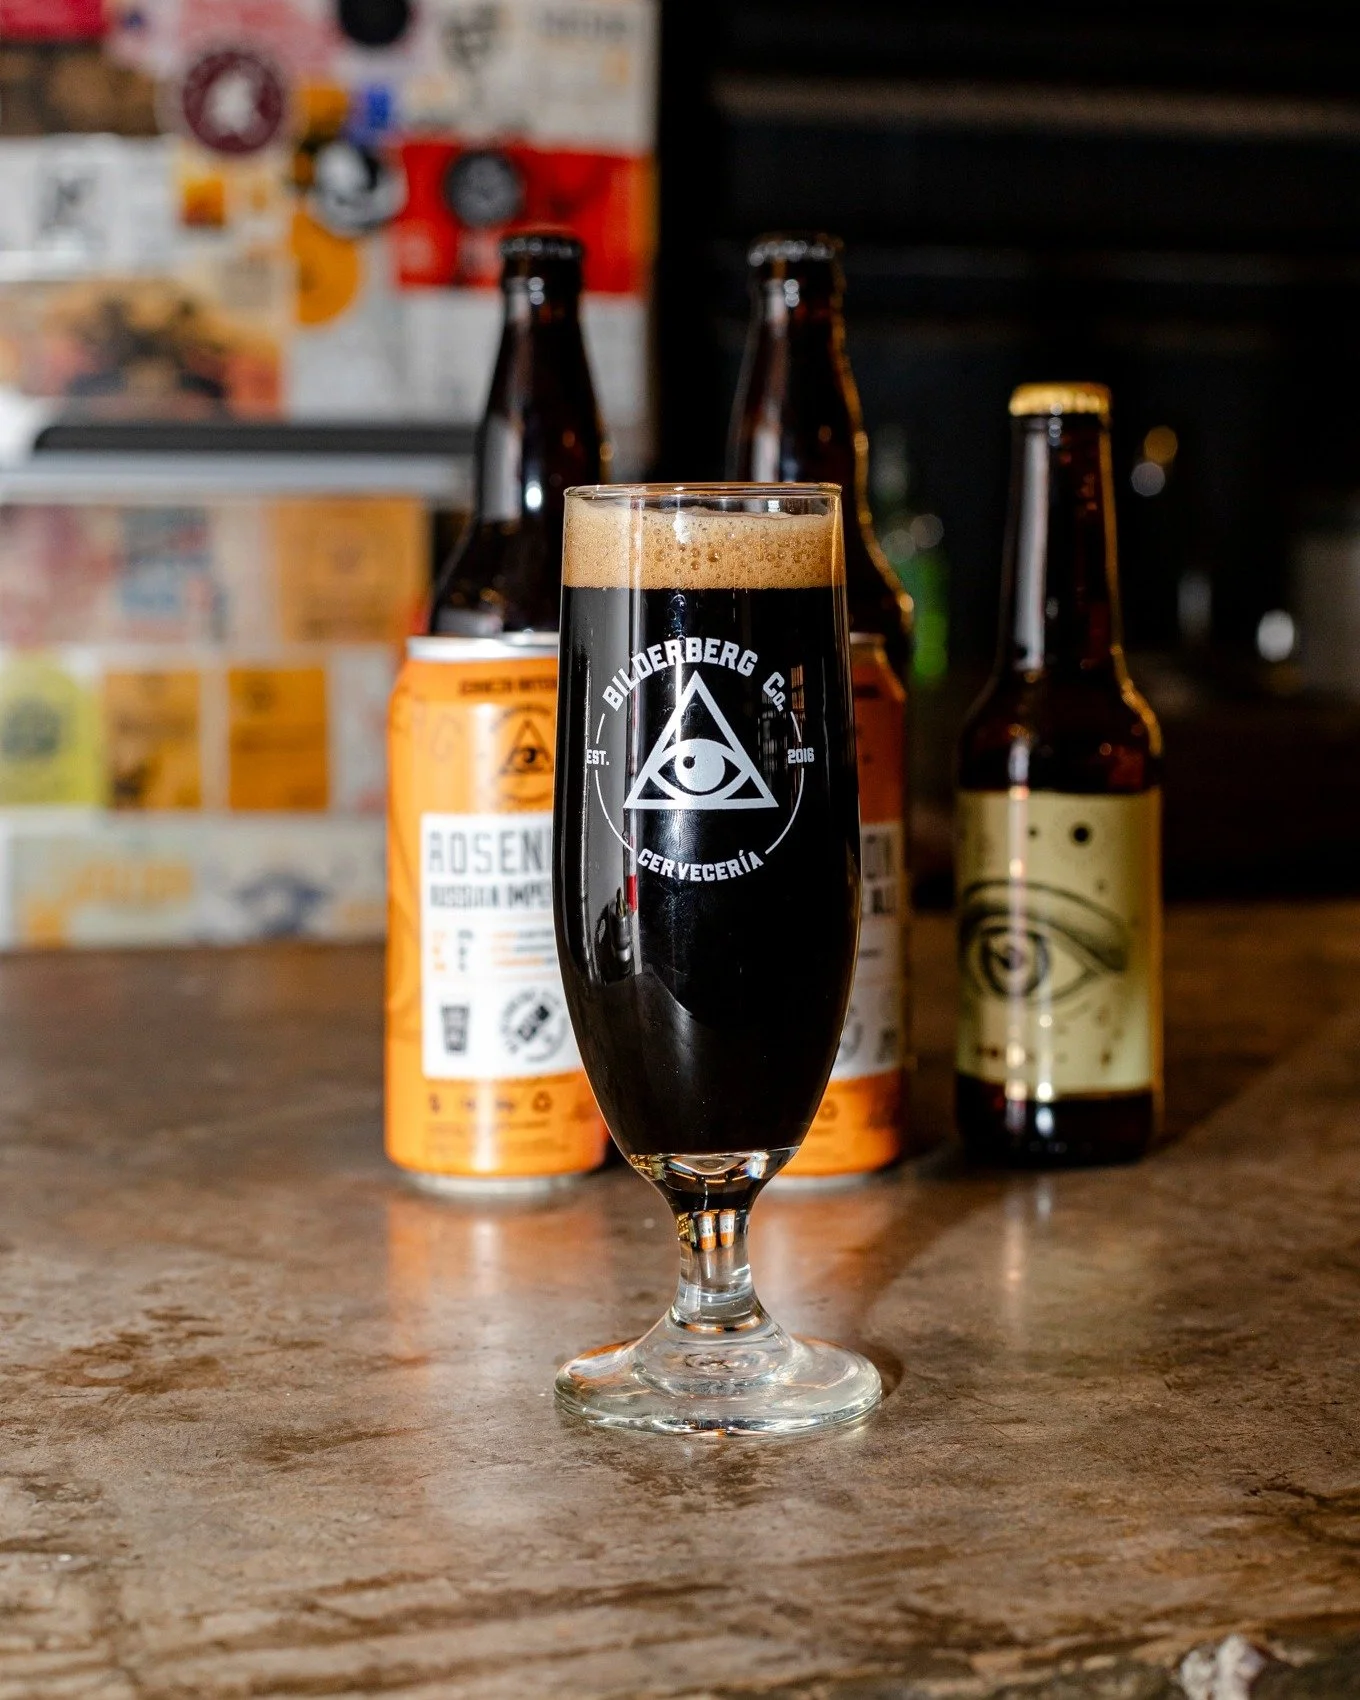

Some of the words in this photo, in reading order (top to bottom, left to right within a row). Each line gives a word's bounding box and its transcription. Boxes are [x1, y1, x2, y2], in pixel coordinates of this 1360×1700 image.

[602, 637, 759, 712] BILDERBERG
[586, 749, 610, 766] EST.
[787, 747, 815, 764] 2016
[637, 850, 765, 882] CERVECERÍA
